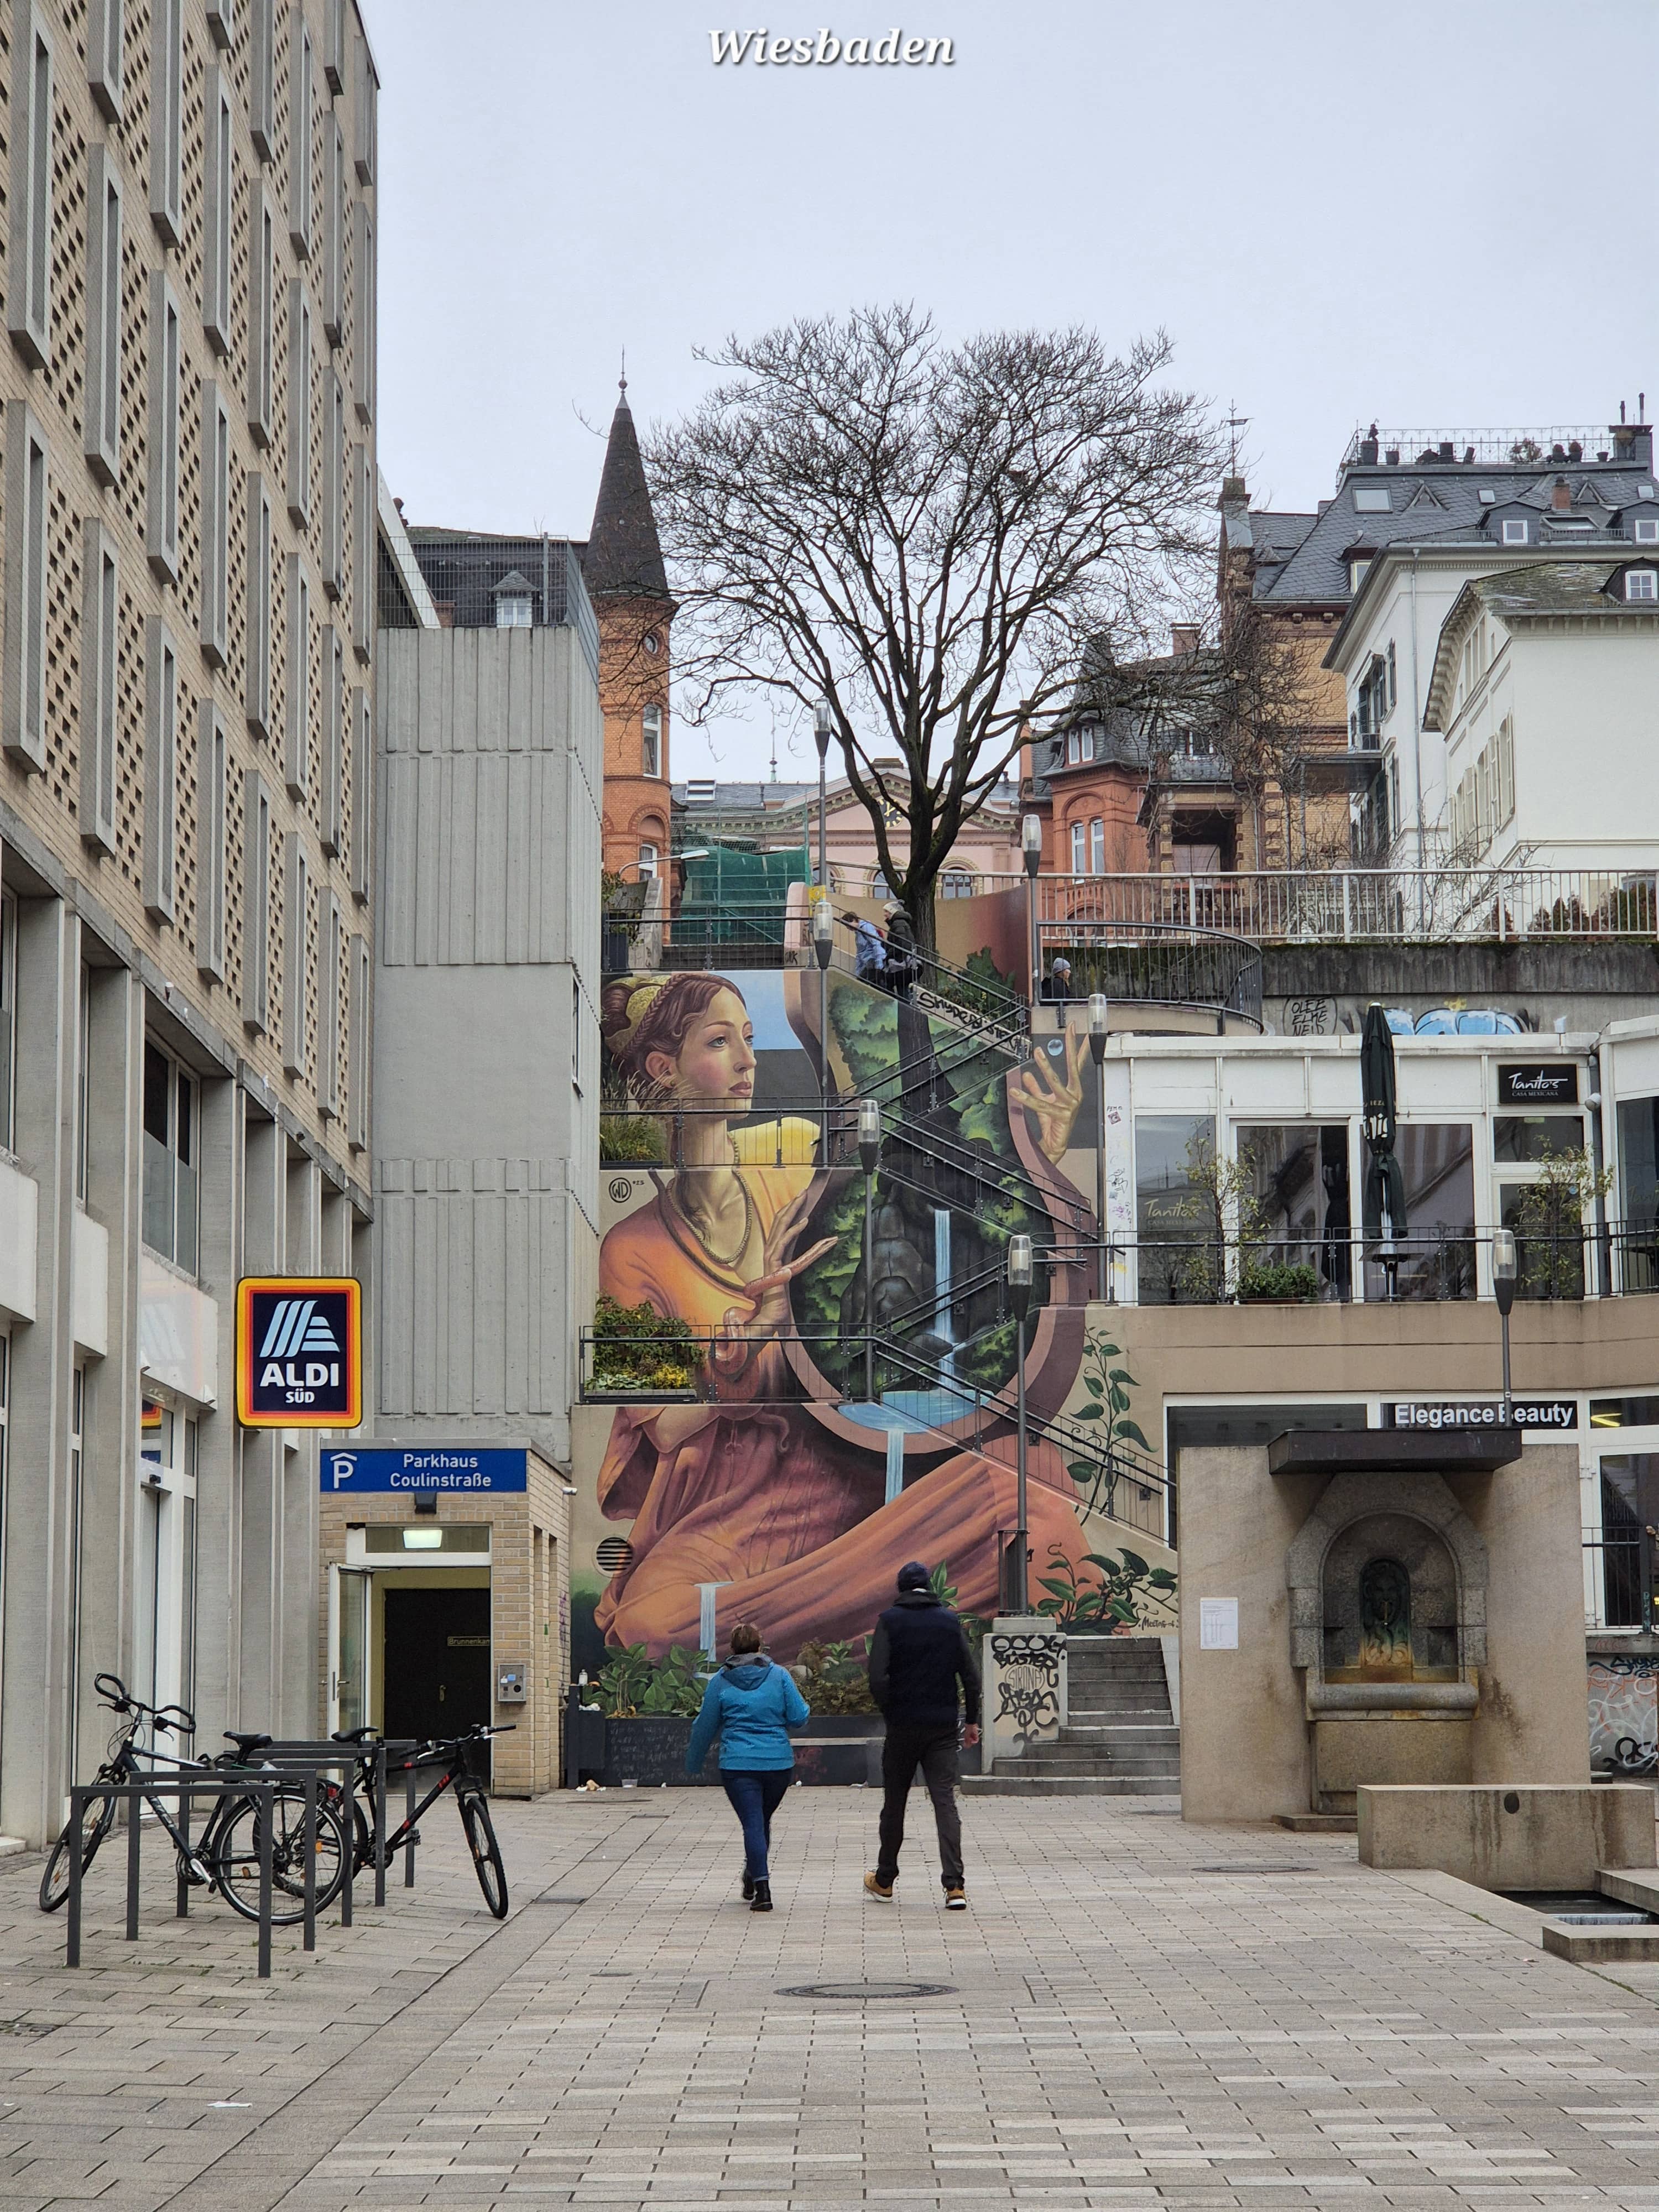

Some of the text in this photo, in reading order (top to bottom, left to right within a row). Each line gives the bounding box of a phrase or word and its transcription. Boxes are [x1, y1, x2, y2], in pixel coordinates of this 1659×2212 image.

[1508, 1070, 1568, 1089] Tanito's
[259, 1363, 339, 1387] ALDI
[285, 1388, 315, 1404] SÜD
[1395, 1404, 1495, 1428] Elegance
[404, 1454, 478, 1468] Parkhaus
[333, 1460, 354, 1489] P
[390, 1472, 492, 1488] Coulinstraße
